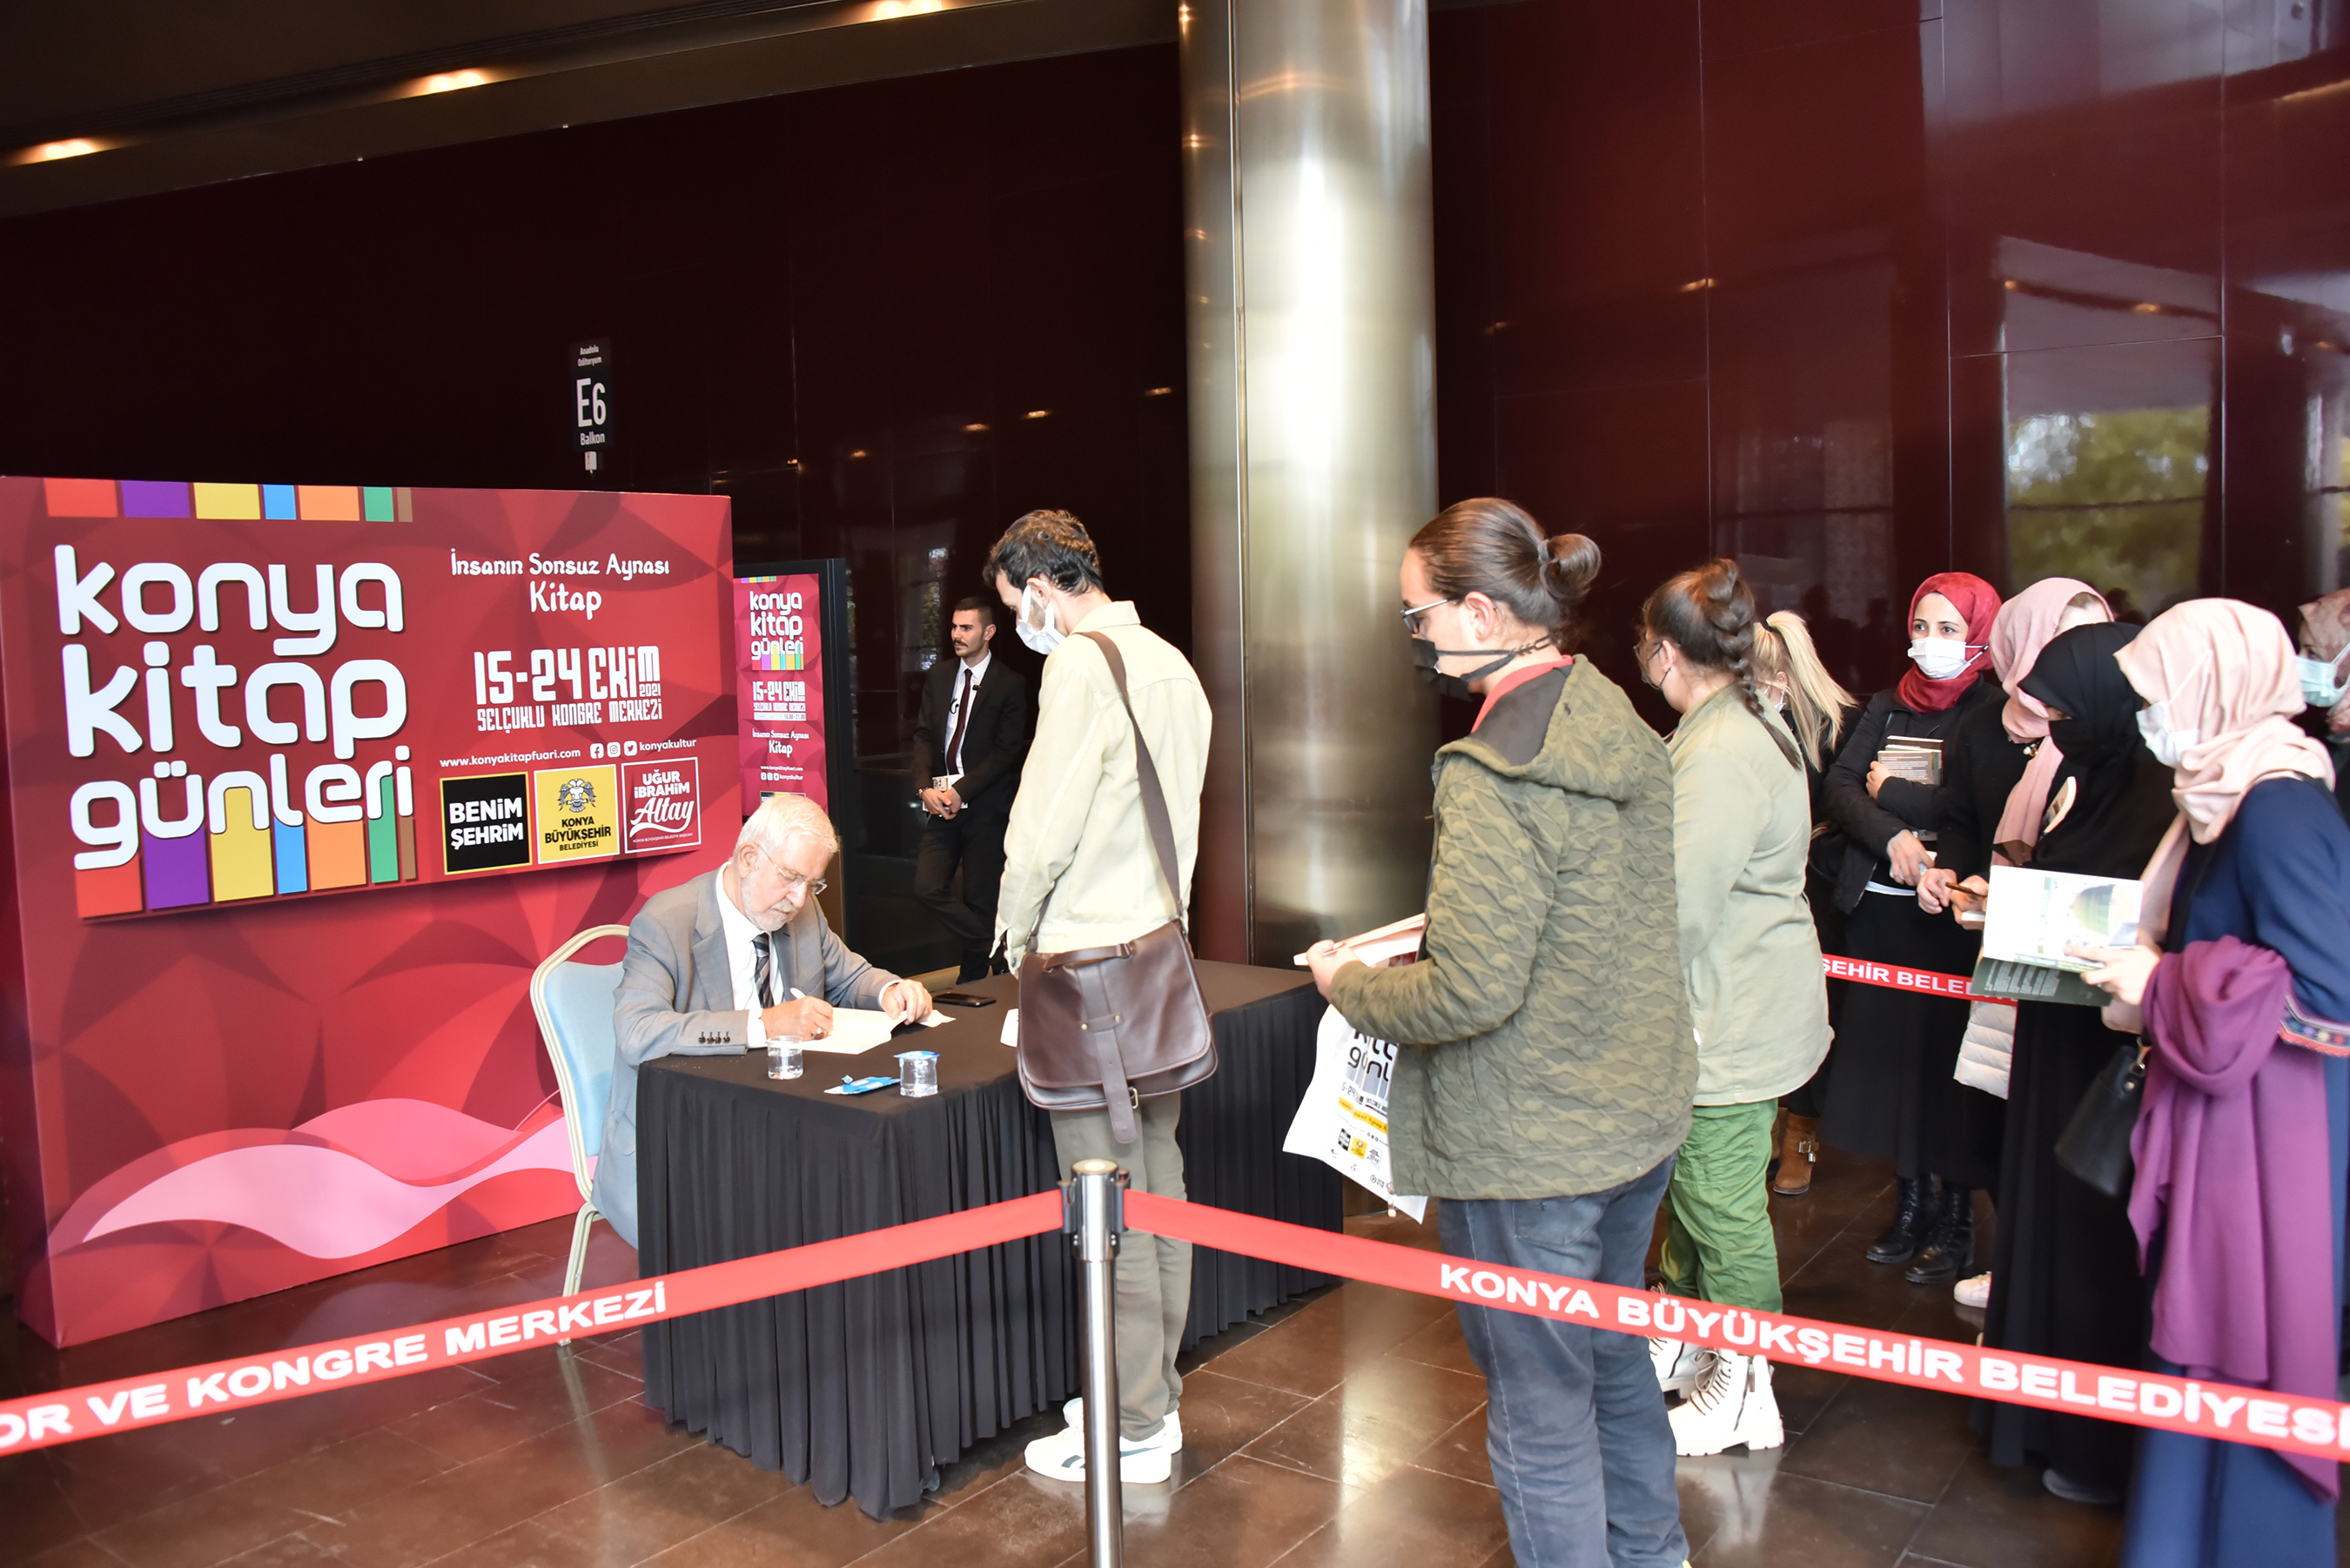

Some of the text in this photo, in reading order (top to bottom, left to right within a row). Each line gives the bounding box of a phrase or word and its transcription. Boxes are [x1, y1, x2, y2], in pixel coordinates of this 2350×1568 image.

[576, 378, 607, 427] E6
[580, 431, 606, 446] Balkon
[450, 547, 670, 581] İnsanın Sonsuz Aynası
[54, 544, 404, 656] konya
[529, 580, 602, 620] Kitap
[749, 590, 802, 616] konya
[750, 611, 803, 640] kitap
[750, 636, 804, 661] günleri
[473, 647, 583, 705] 15-24
[62, 640, 407, 760] kitap
[639, 683, 661, 697] 2021
[752, 680, 782, 701] 15-24
[477, 698, 662, 734] SELÇUKLU KONGRE MERKEZİ
[440, 748, 581, 767] www.konyakitapfuari.com
[639, 739, 697, 752] konyakultur
[769, 740, 793, 758] Kitap
[642, 768, 681, 786] UĞUR
[70, 745, 414, 871] günleri
[561, 815, 595, 828] KONYA
[629, 797, 695, 834] Altay
[544, 824, 612, 844] BÜYÜKŞEHİR
[559, 840, 599, 851] BELEDİYESİ
[1440, 1263, 1600, 1318] KONYA
[1618, 1297, 1964, 1384] BÜYÜKŞEHİR
[86, 1384, 170, 1426] VE
[186, 1335, 429, 1407] KONGRE
[445, 1282, 667, 1356] MERKEZİ
